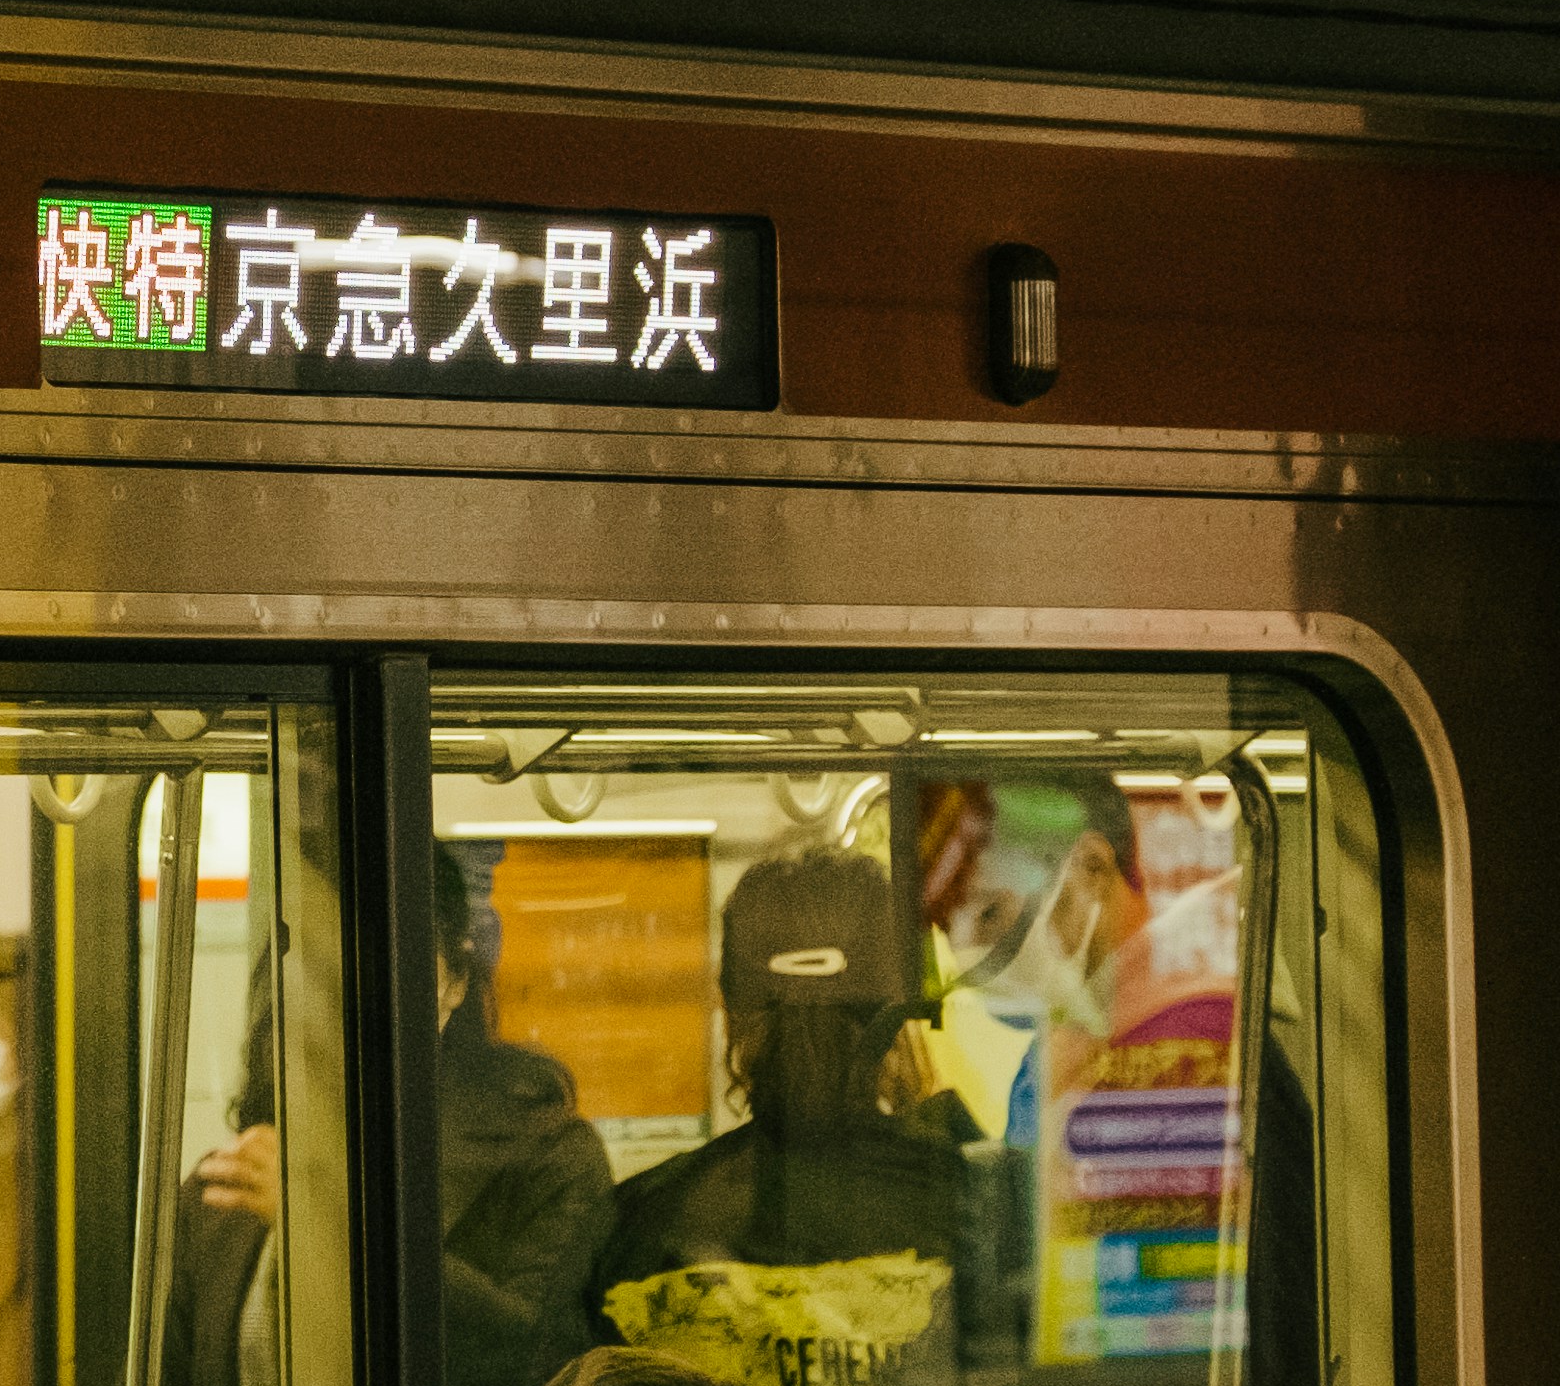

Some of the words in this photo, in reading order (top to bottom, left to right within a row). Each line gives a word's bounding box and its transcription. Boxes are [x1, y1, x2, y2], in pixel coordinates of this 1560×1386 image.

[38, 205, 206, 340] 快特
[221, 208, 718, 371] 京急久里浜
